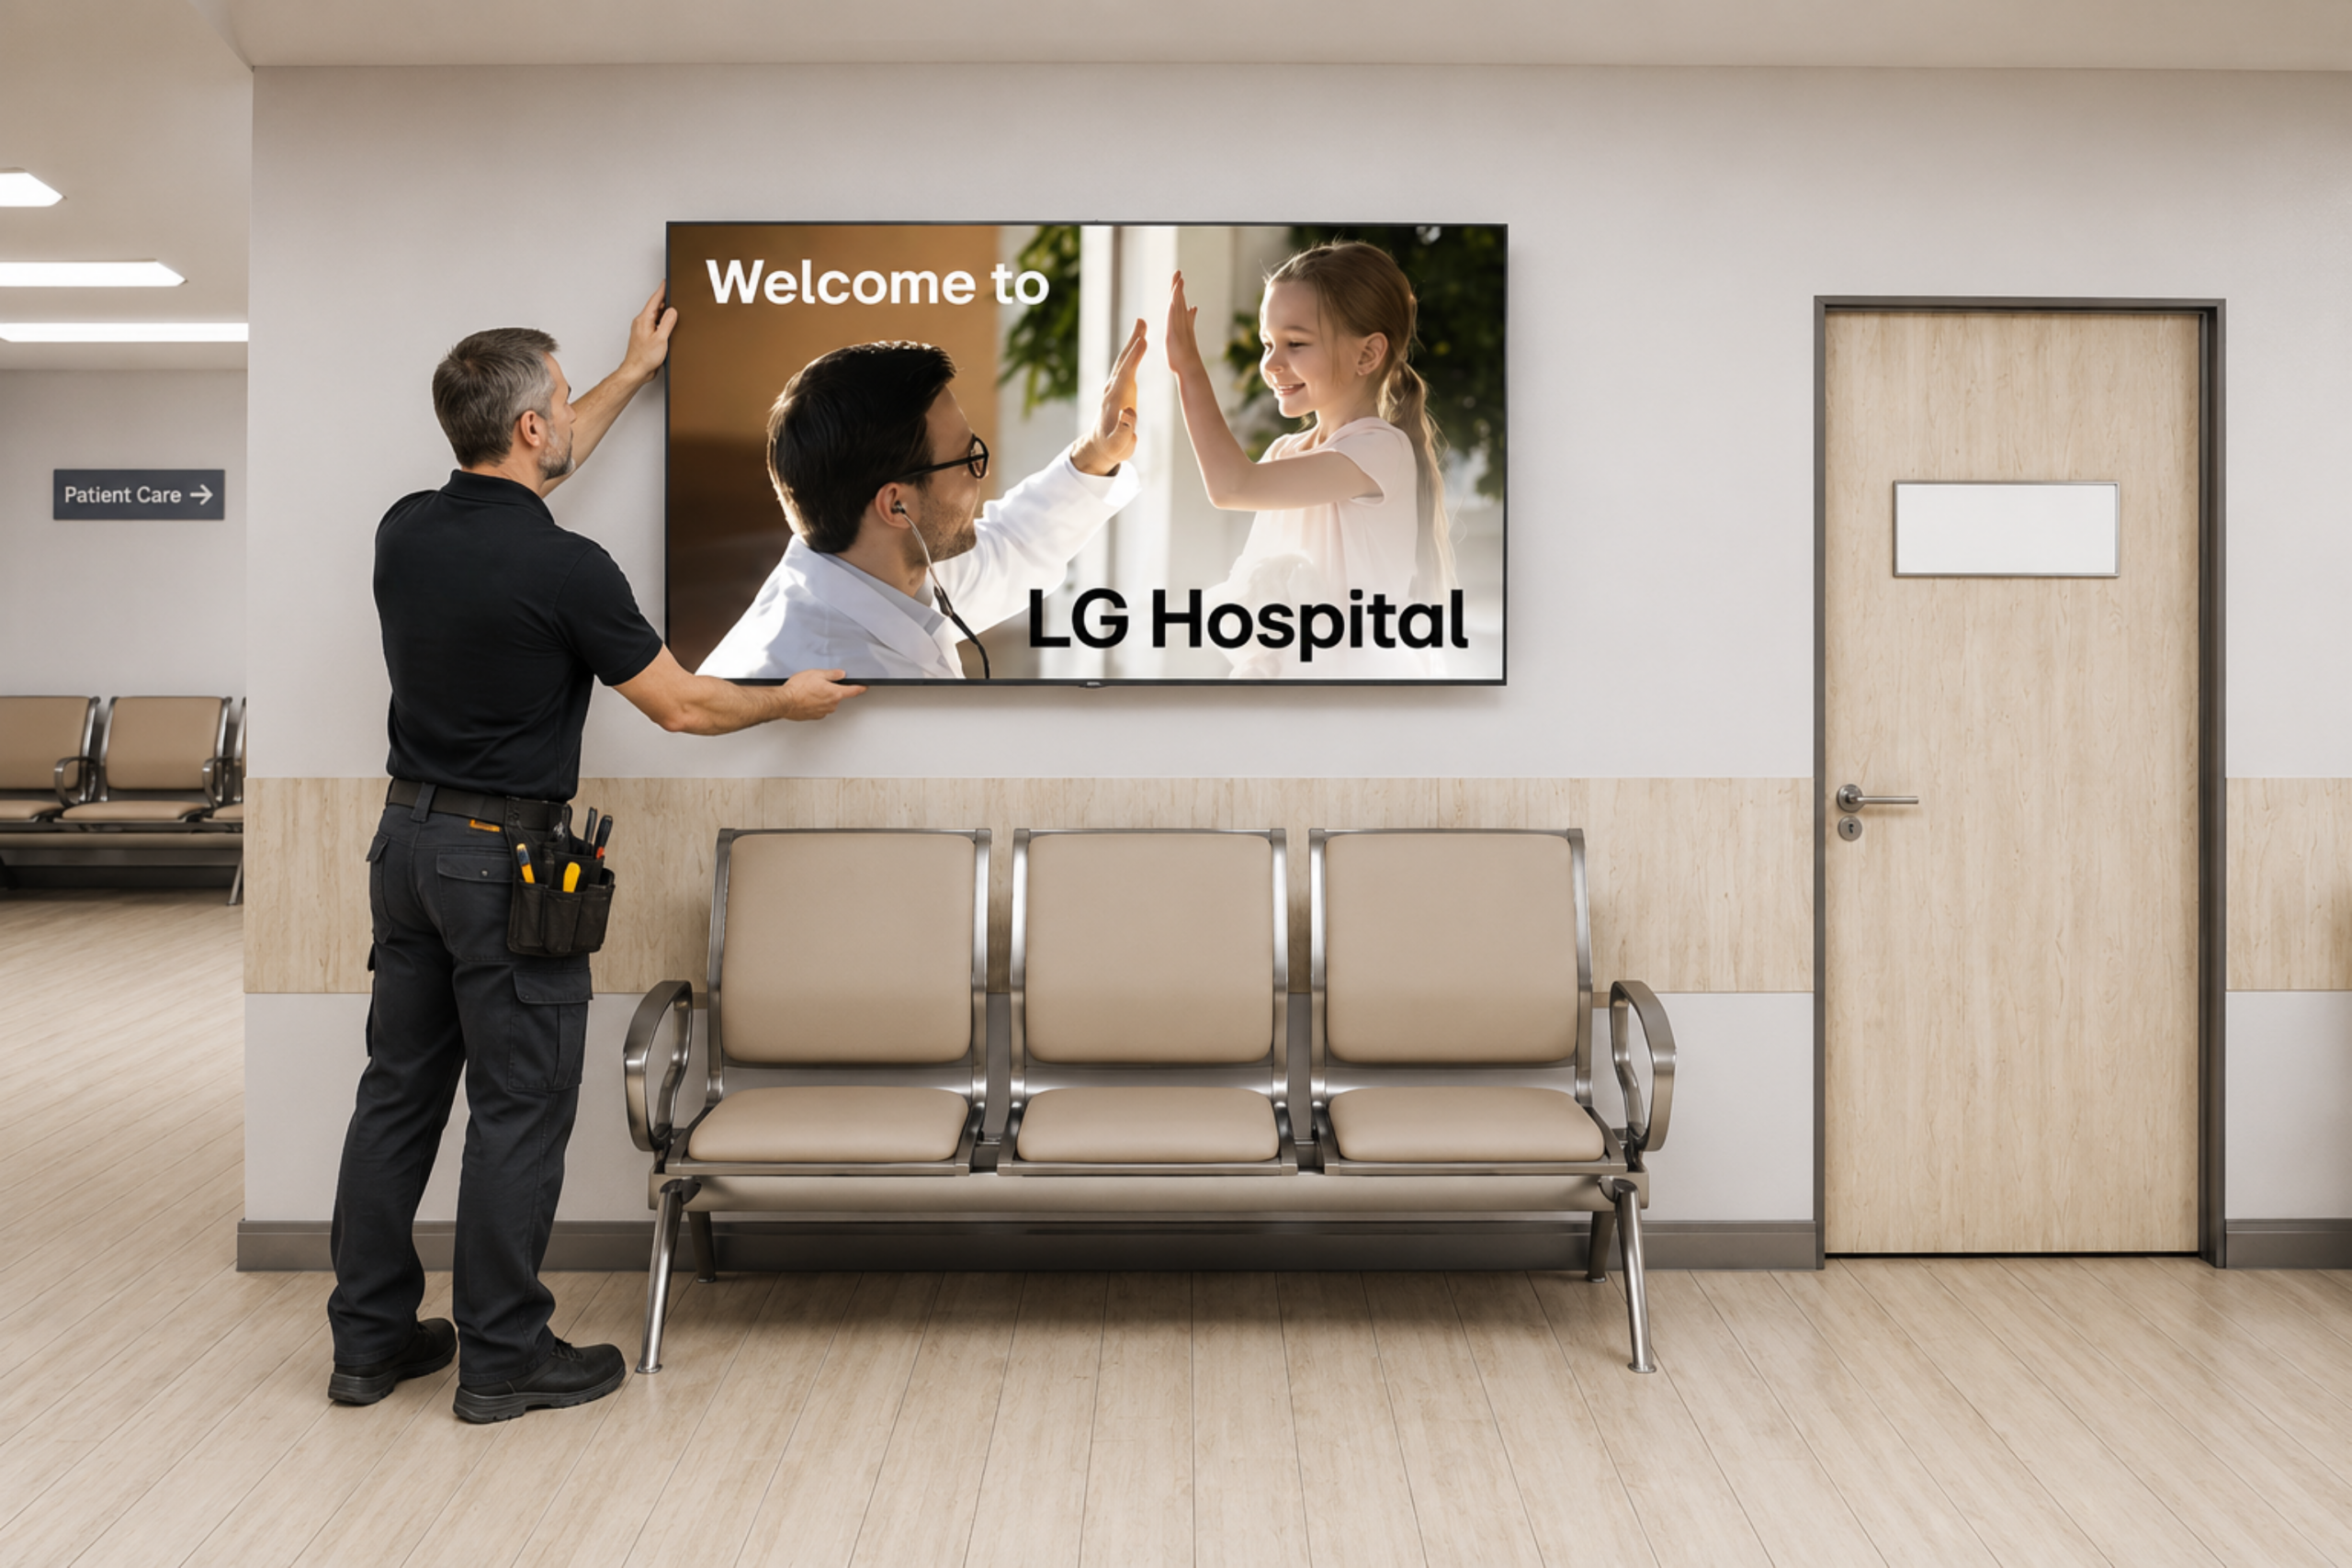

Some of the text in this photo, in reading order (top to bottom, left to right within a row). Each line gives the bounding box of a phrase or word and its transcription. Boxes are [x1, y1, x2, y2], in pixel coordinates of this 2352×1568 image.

[706, 259, 1050, 305] Welcome to
[64, 486, 182, 503] Patient Care
[1029, 587, 1469, 662] LG Hospital
